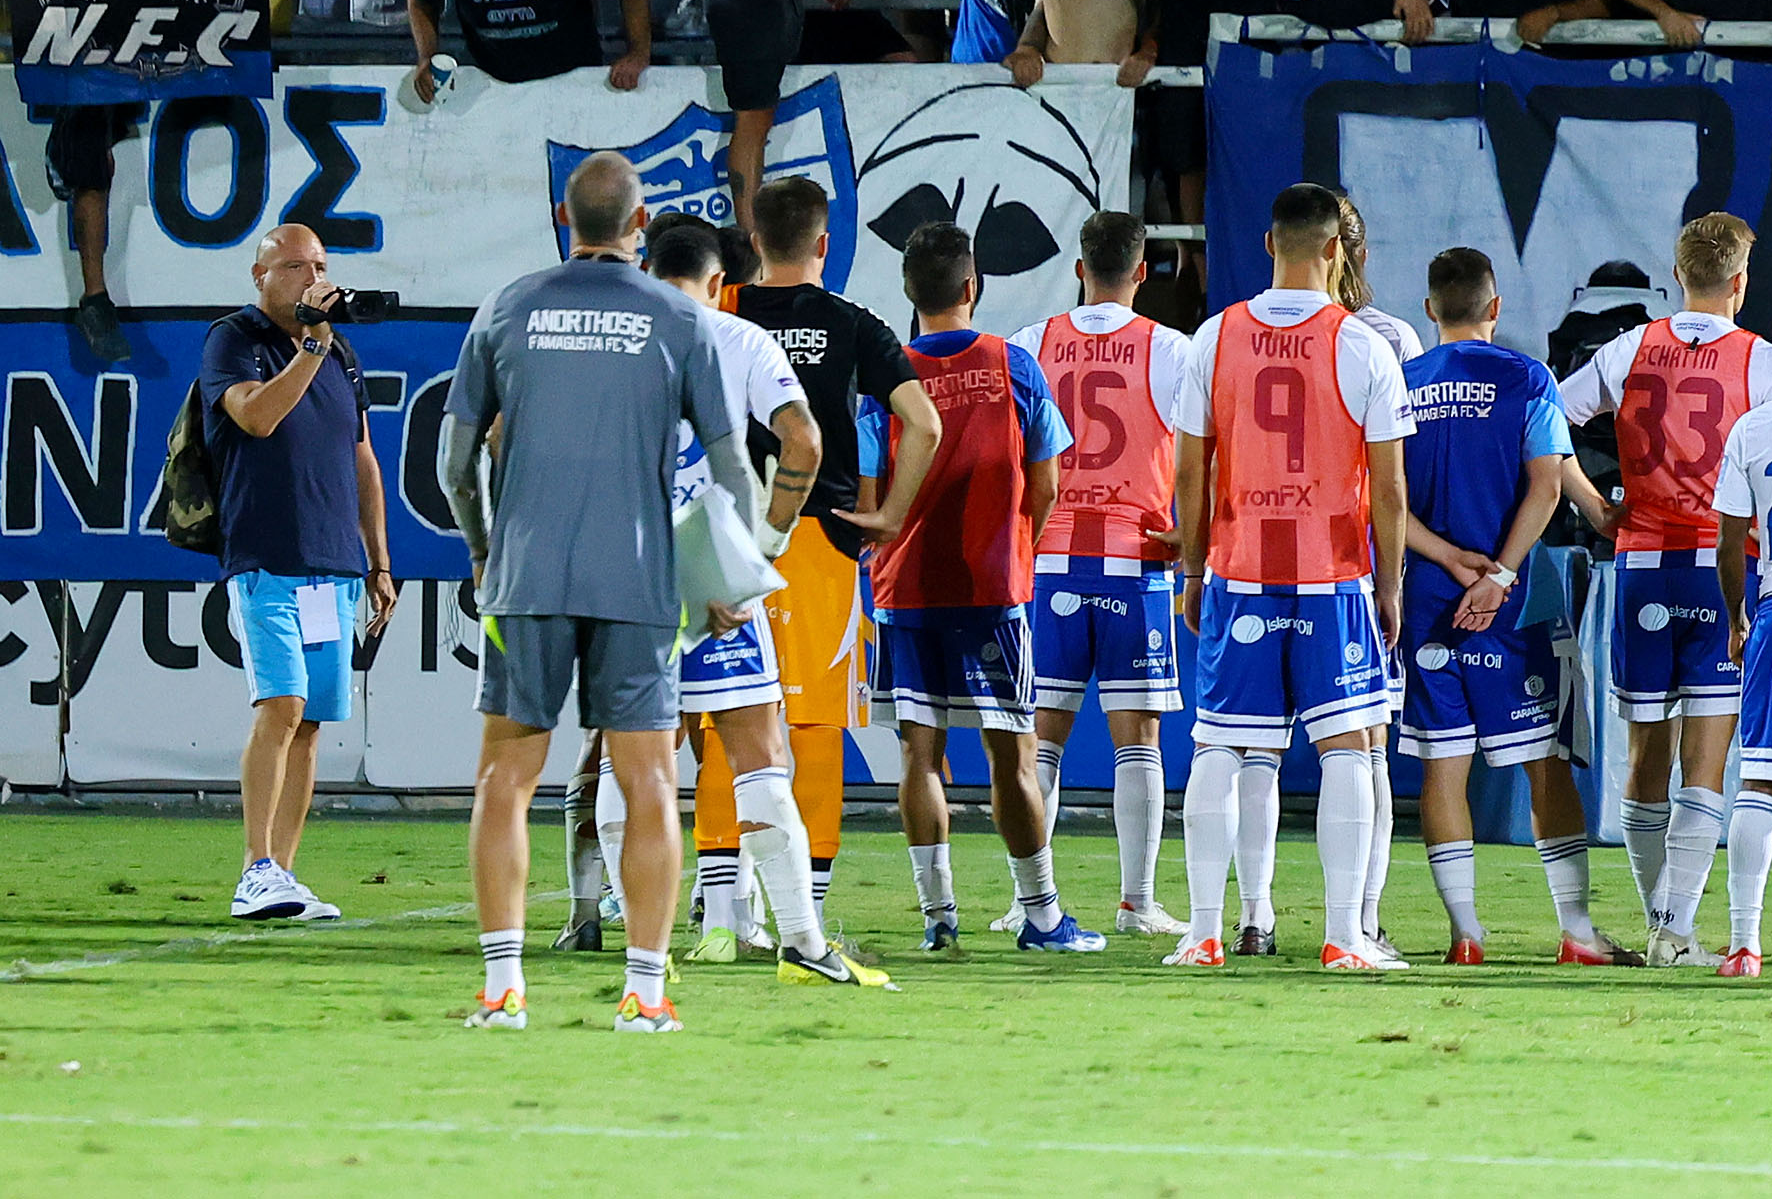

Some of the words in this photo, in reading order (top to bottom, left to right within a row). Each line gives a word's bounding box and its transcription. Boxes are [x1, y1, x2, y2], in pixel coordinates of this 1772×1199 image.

[21, 3, 261, 68] N.F.C
[526, 308, 654, 339] ANORTHOSIS
[527, 333, 604, 352] FAMAGUSTA
[603, 336, 624, 353] FC
[1054, 340, 1077, 364] DA
[1084, 338, 1136, 365] SILVA
[1251, 331, 1314, 360] VUKIC
[789, 350, 805, 365] FC
[1057, 369, 1128, 471] 15
[1253, 365, 1305, 474] 9
[1460, 404, 1474, 419] FC
[1623, 373, 1724, 479] 33
[1111, 599, 1128, 617] Oil
[1698, 609, 1717, 624] Oil
[1297, 620, 1313, 636] Oil
[1484, 654, 1502, 669] Oil
